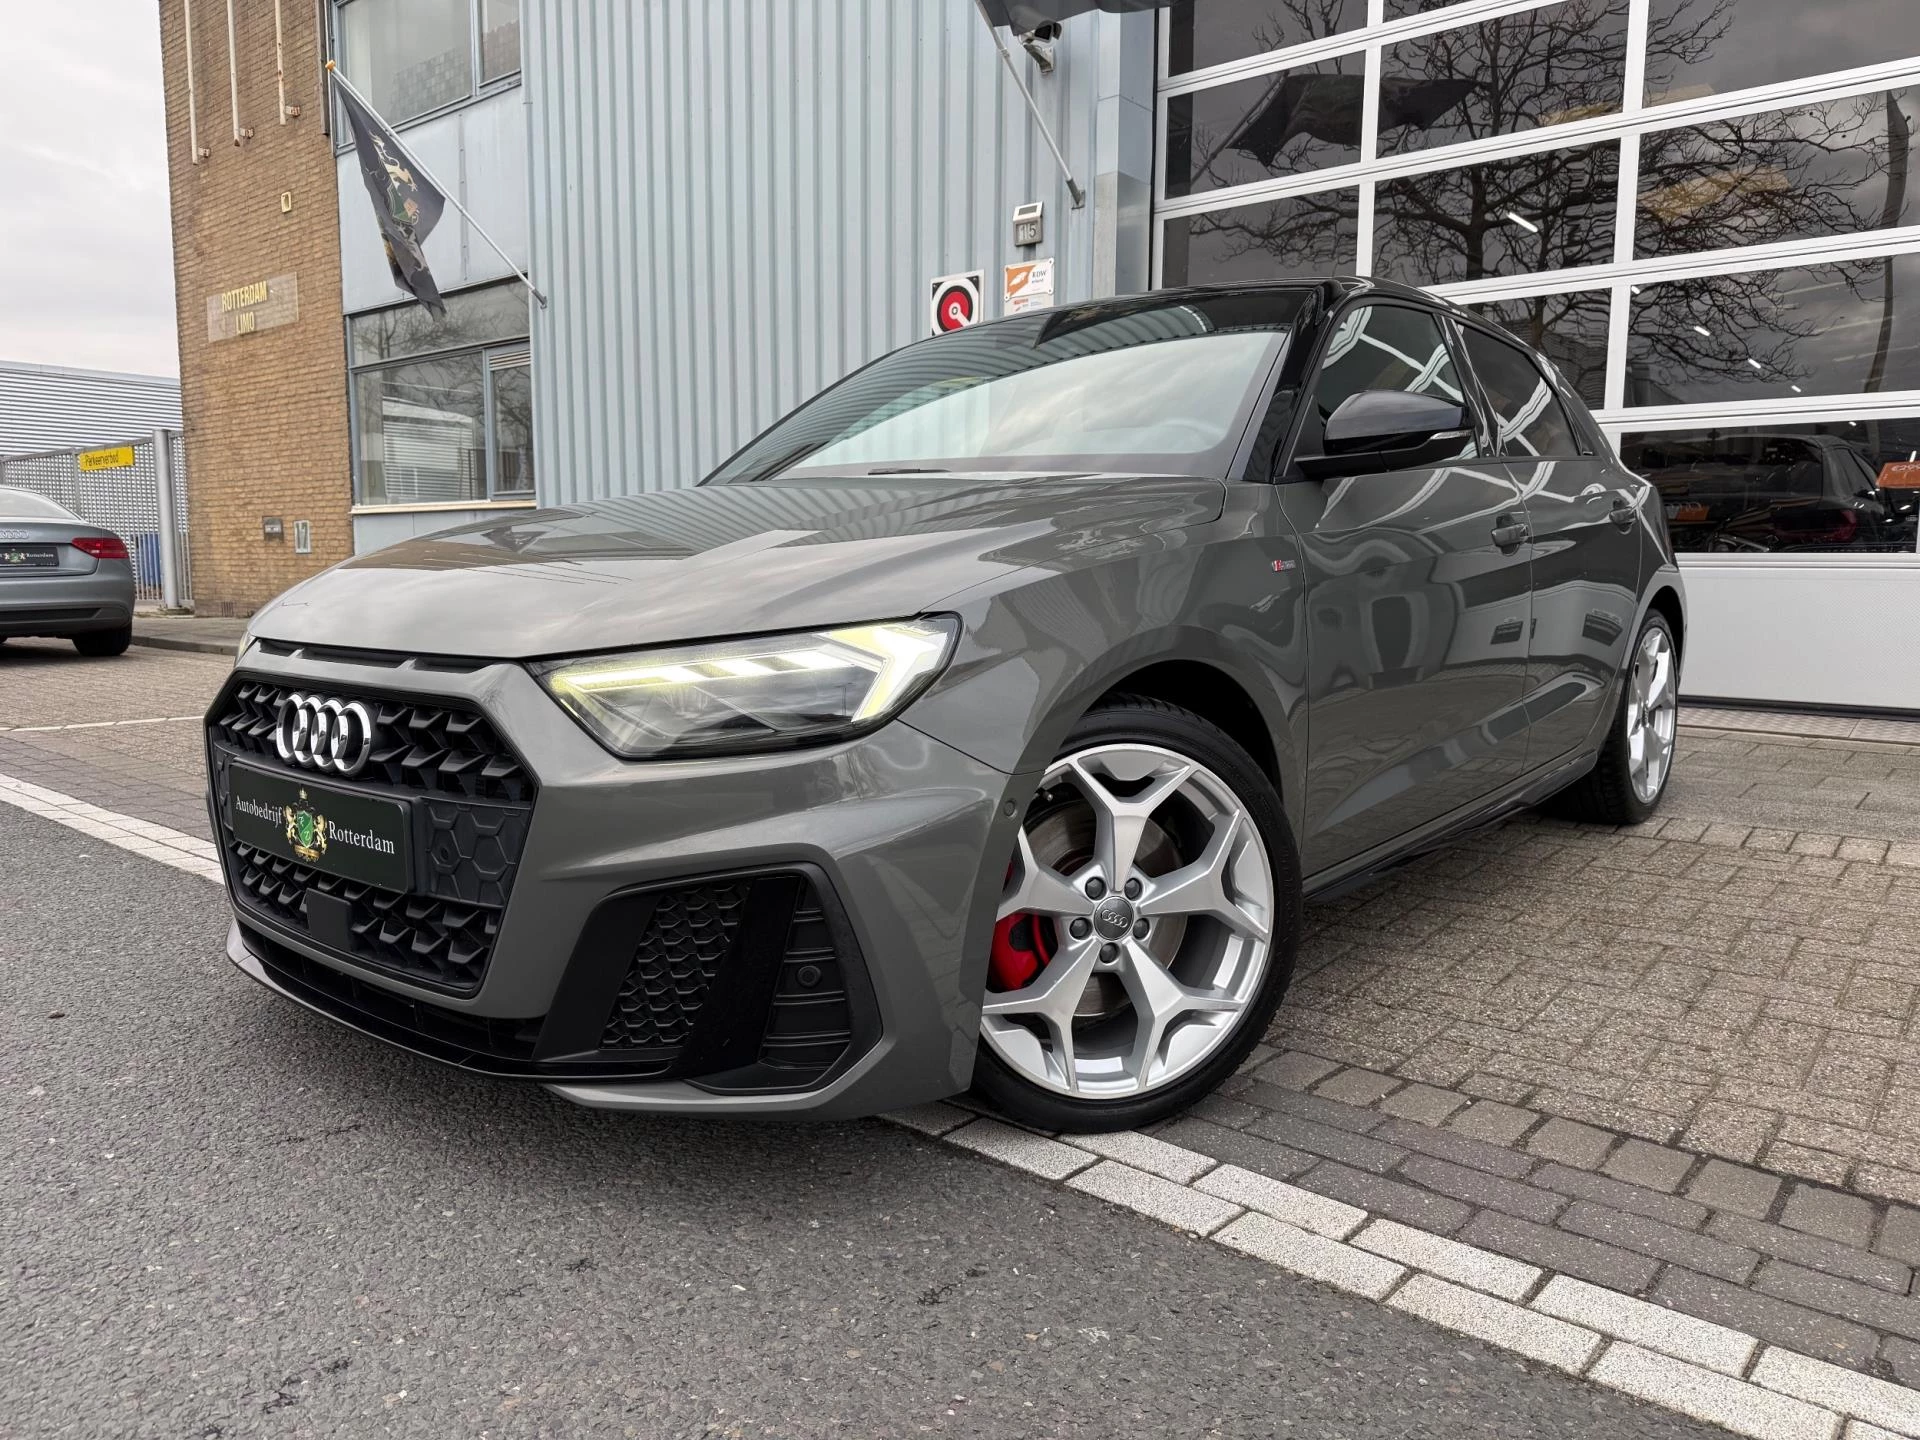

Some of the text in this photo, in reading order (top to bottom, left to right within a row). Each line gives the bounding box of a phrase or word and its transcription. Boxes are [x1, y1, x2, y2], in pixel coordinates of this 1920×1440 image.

[1020, 223, 1036, 240] 15
[222, 280, 267, 312] ROTTERDAM
[236, 311, 255, 335] LIMO
[235, 795, 395, 854] Autobedrijf Rotterdam
